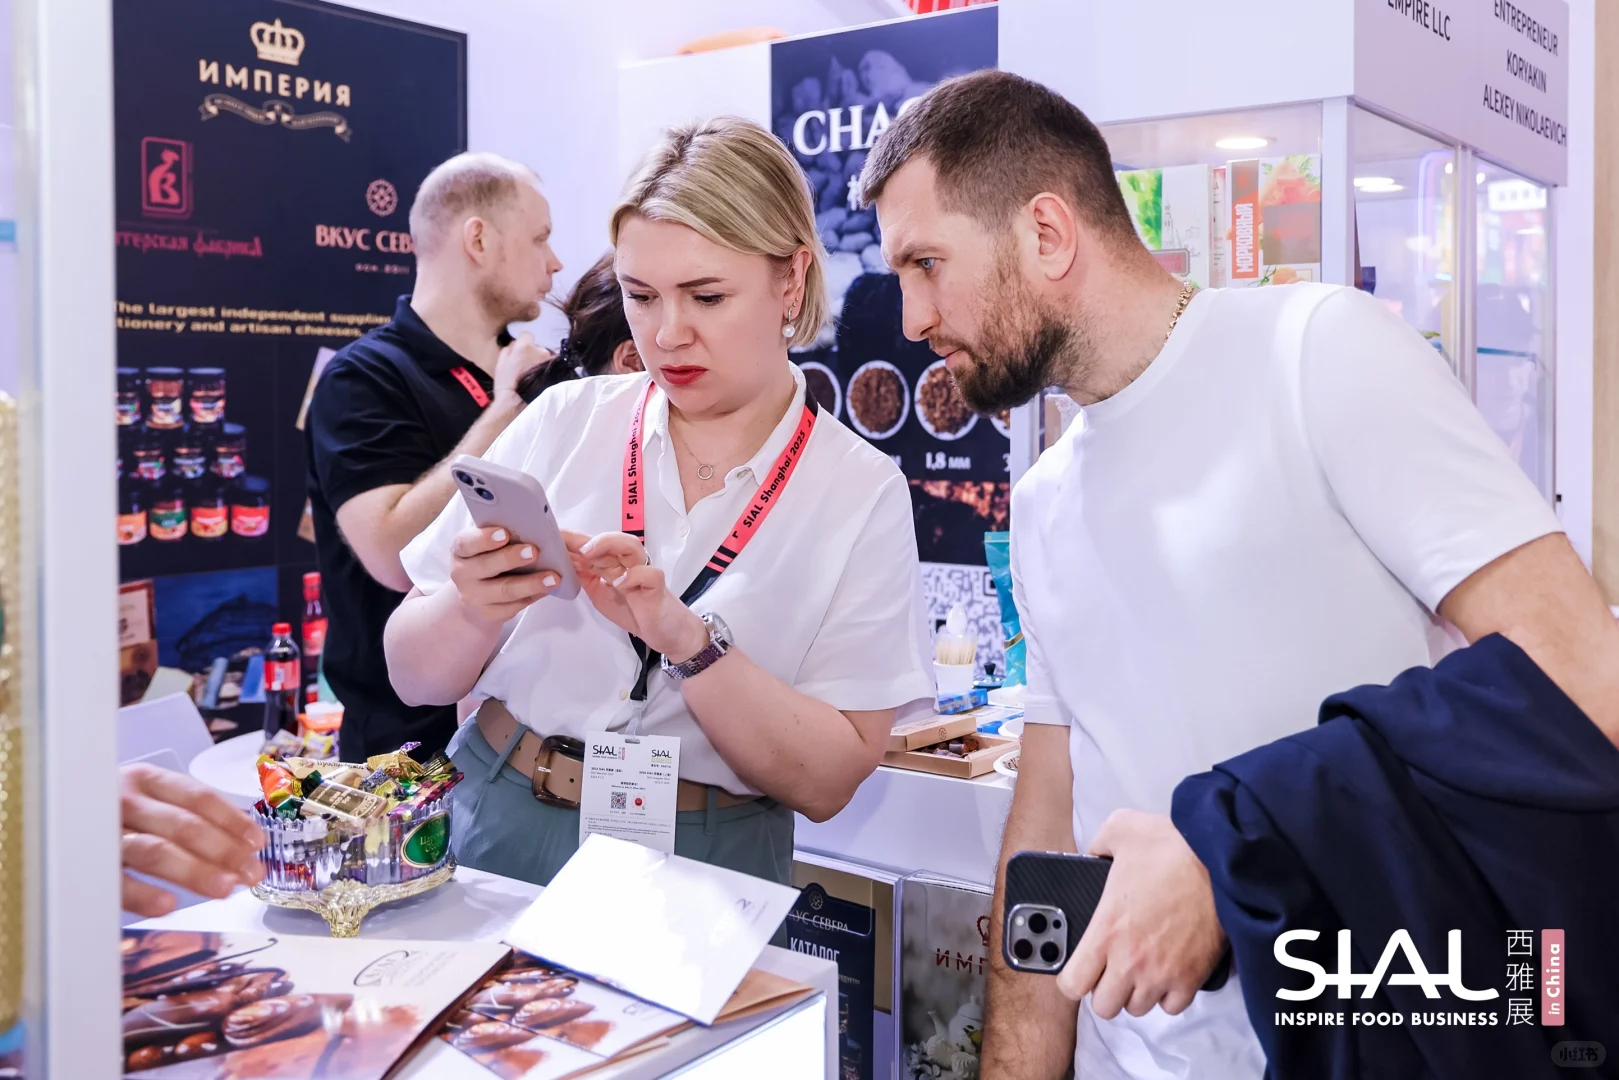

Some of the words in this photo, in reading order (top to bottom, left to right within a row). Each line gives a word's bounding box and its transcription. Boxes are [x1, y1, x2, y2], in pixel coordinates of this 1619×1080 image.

[1388, 0, 1429, 29] PIRE
[1433, 7, 1450, 41] LLC
[1494, 0, 1558, 56] ENTREPRENEUR
[199, 59, 351, 107] ИМПЕРИЯ
[1506, 49, 1547, 93] KORYAKIN
[793, 98, 915, 155] CHA
[1483, 84, 1515, 120] ALEXEY
[1516, 102, 1567, 147] NIKOLAEVICH
[315, 224, 370, 251] ВКУС
[375, 230, 415, 254] СЕВ
[115, 317, 186, 333] tionery
[190, 321, 225, 332] and
[229, 322, 291, 335] artisan
[149, 302, 216, 319] largest
[221, 305, 325, 322] independent
[628, 428, 639, 477] Shanghai
[926, 452, 946, 470] 1,8
[628, 480, 637, 505] SIAL
[743, 501, 763, 527] SIAL
[760, 455, 792, 503] Shanghai
[790, 430, 806, 455] 2025
[593, 745, 617, 756] SIAL
[651, 749, 672, 759] SIAL
